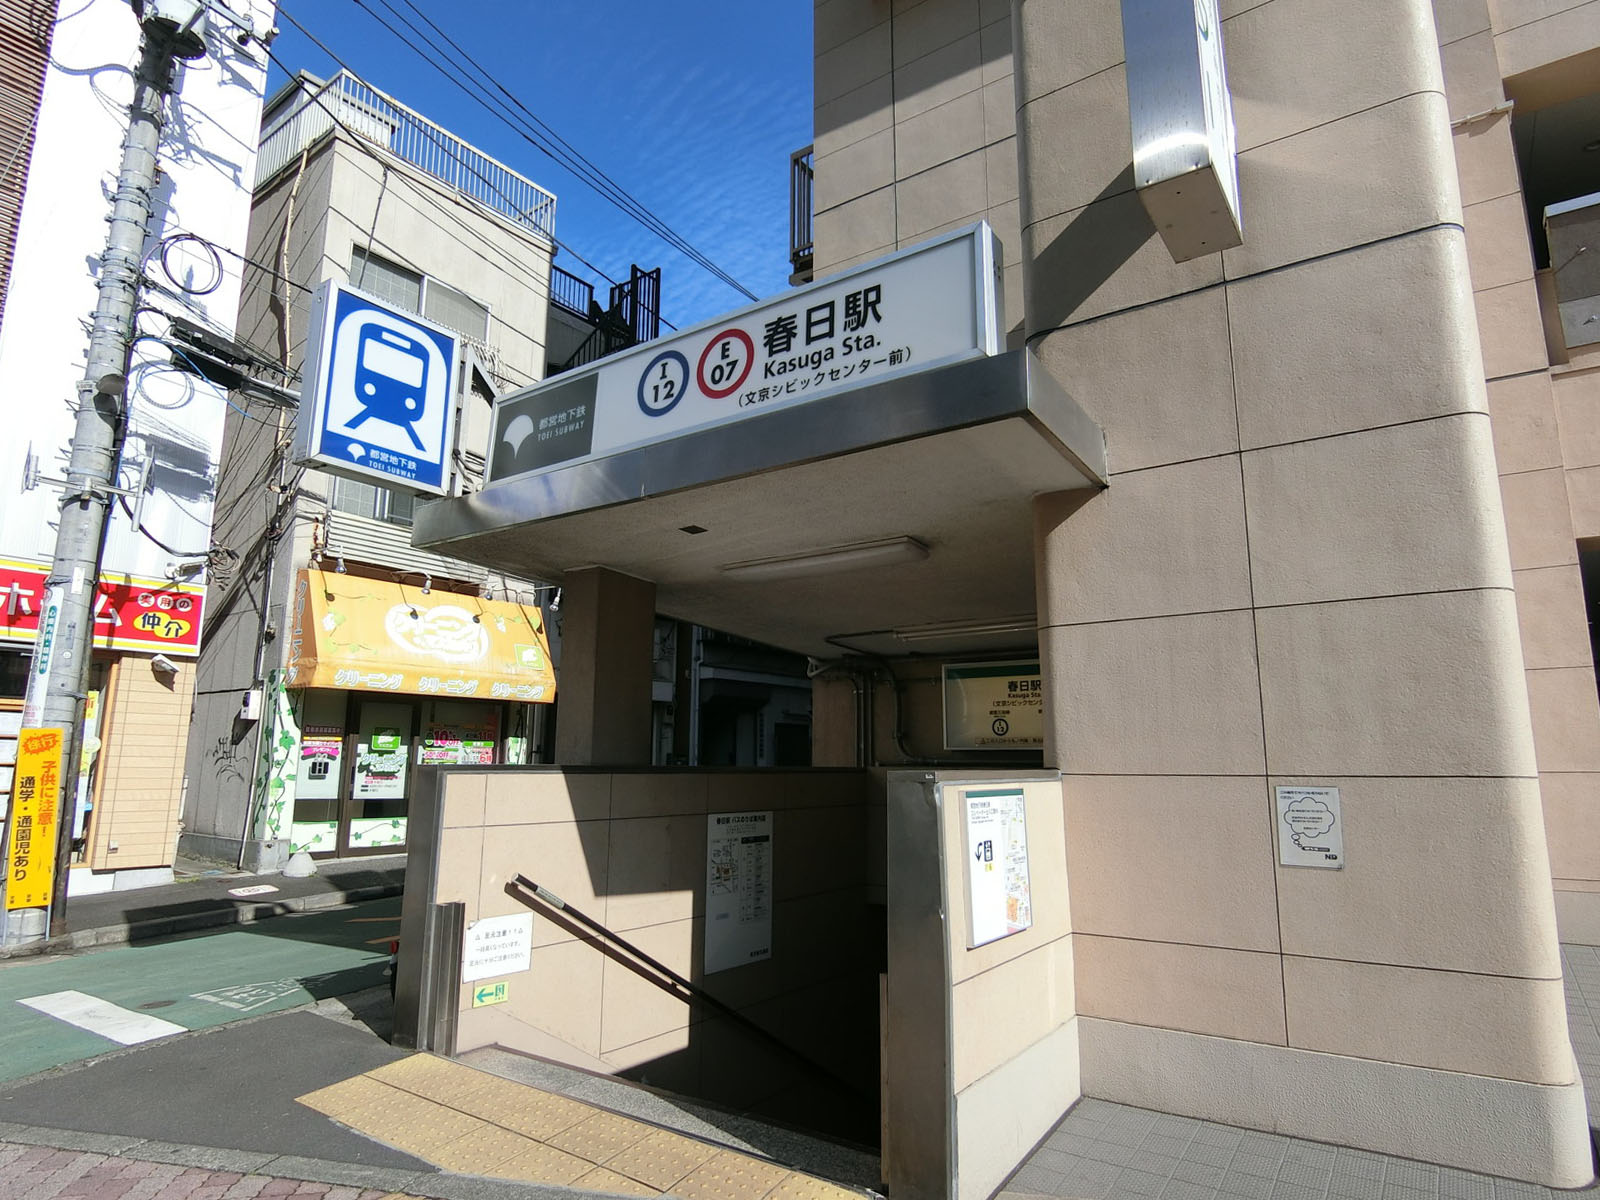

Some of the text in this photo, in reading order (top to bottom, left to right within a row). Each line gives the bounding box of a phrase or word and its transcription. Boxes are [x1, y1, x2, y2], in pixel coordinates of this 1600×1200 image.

[762, 284, 882, 358] 春日駅
[720, 341, 731, 360] E
[763, 334, 882, 380] Kasuga Sta.
[659, 362, 669, 380] I
[710, 359, 739, 385] 07
[738, 346, 913, 408] （文京シビックセンター前）
[653, 380, 675, 403] 12
[538, 404, 587, 430] 都営地下鉄
[537, 420, 585, 442] TOEI SUBWAY
[368, 461, 417, 479] TOEI SUBWAY
[369, 448, 418, 471] 都営地下鉄
[0, 582, 122, 628] ホム
[141, 612, 183, 638] 仲介
[285, 579, 308, 687] クリーニング
[334, 669, 404, 690] クリーニング
[418, 676, 479, 695] クリーニング
[491, 682, 546, 699] クリーニング
[1007, 679, 1041, 692] 春日駅
[26, 733, 57, 751] 徐行
[14, 776, 36, 882] 通学・通園児あり
